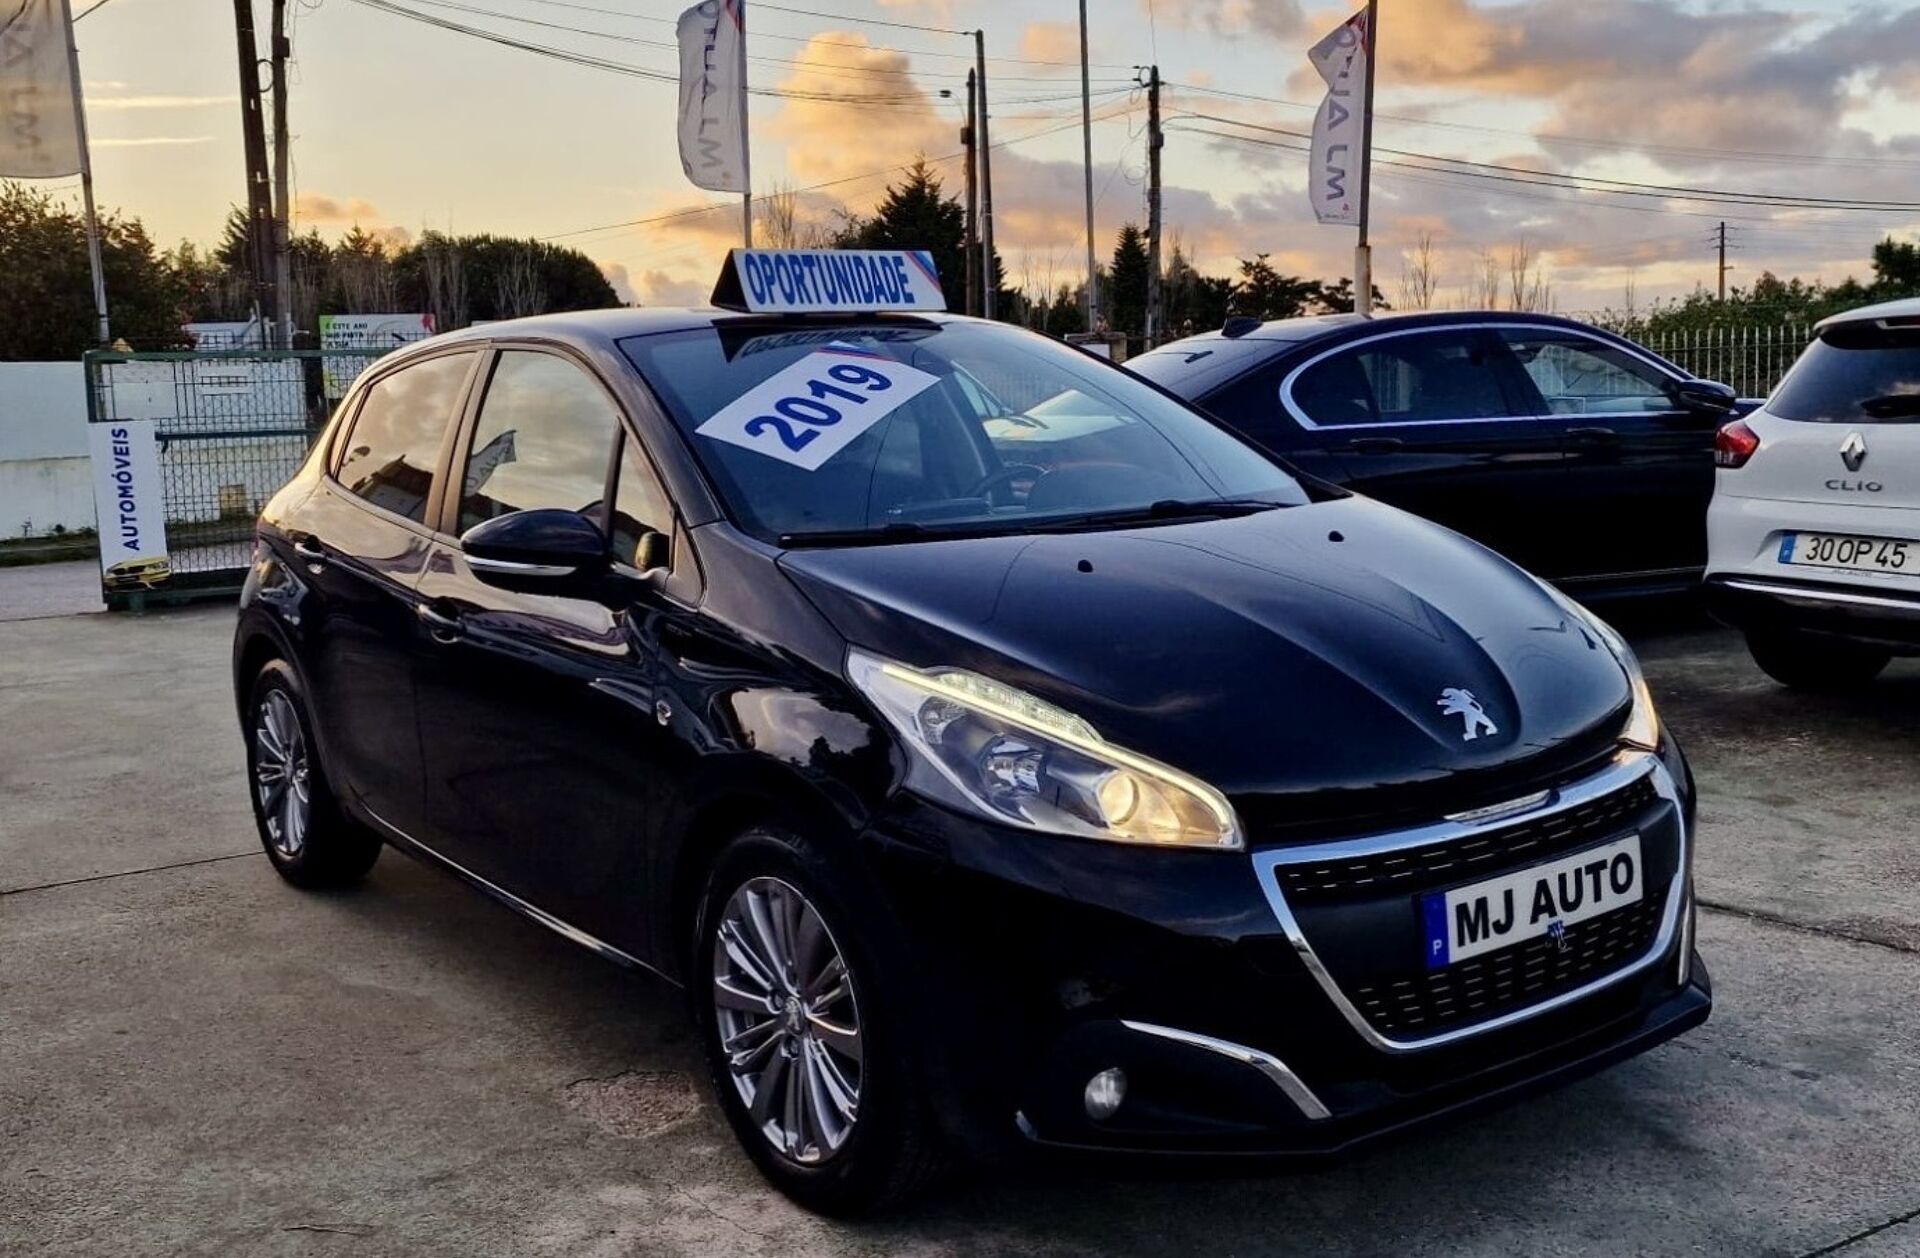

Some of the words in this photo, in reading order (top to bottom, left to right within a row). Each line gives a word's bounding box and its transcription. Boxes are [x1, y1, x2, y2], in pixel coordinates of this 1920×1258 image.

[745, 253, 915, 305] OPORTUNIDADE
[744, 364, 892, 452] 2019
[111, 428, 140, 550] AUTOMÓVEIS
[1825, 480, 1882, 492] CLIO
[1455, 888, 1514, 948] MJ
[1530, 852, 1634, 924] AUTO
[1432, 938, 1443, 956] P
